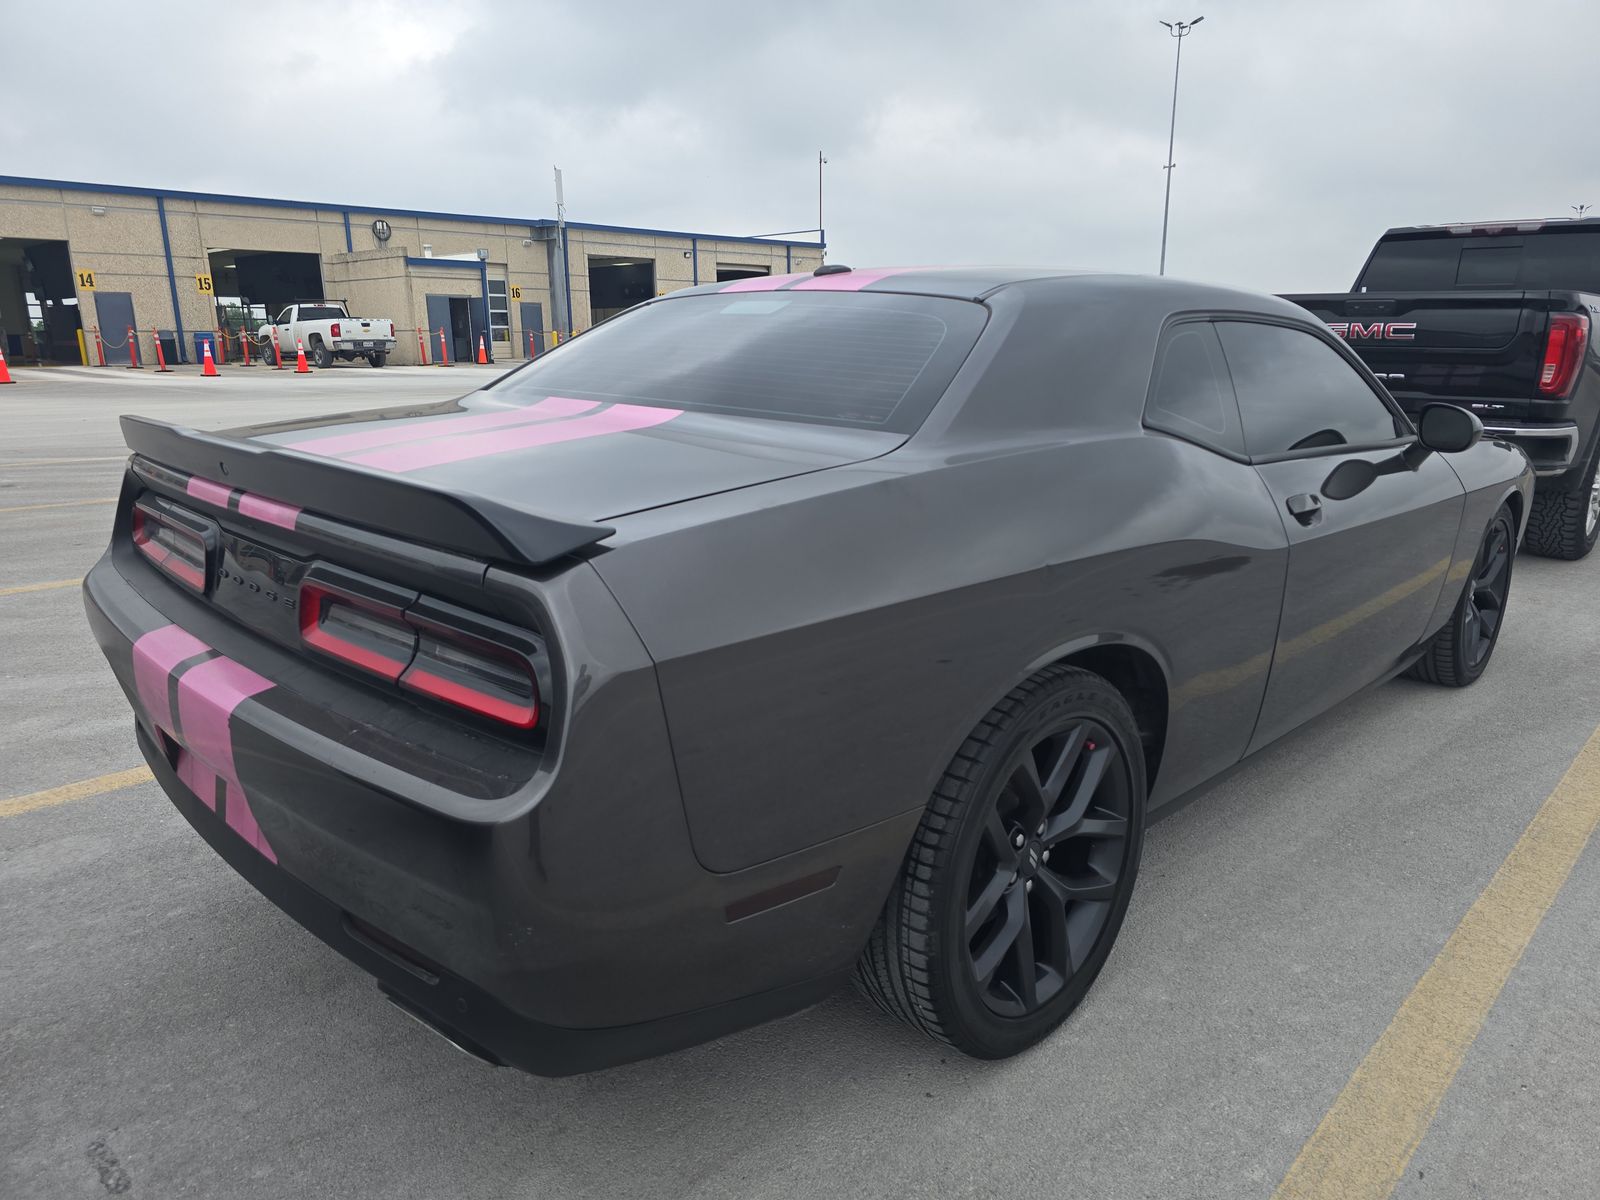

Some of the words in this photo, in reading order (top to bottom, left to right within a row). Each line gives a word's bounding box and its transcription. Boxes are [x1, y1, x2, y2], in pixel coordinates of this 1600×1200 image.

[79, 273, 94, 287] 14
[198, 277, 211, 290] 15
[511, 287, 521, 298] 16
[216, 567, 296, 609] DODGE
